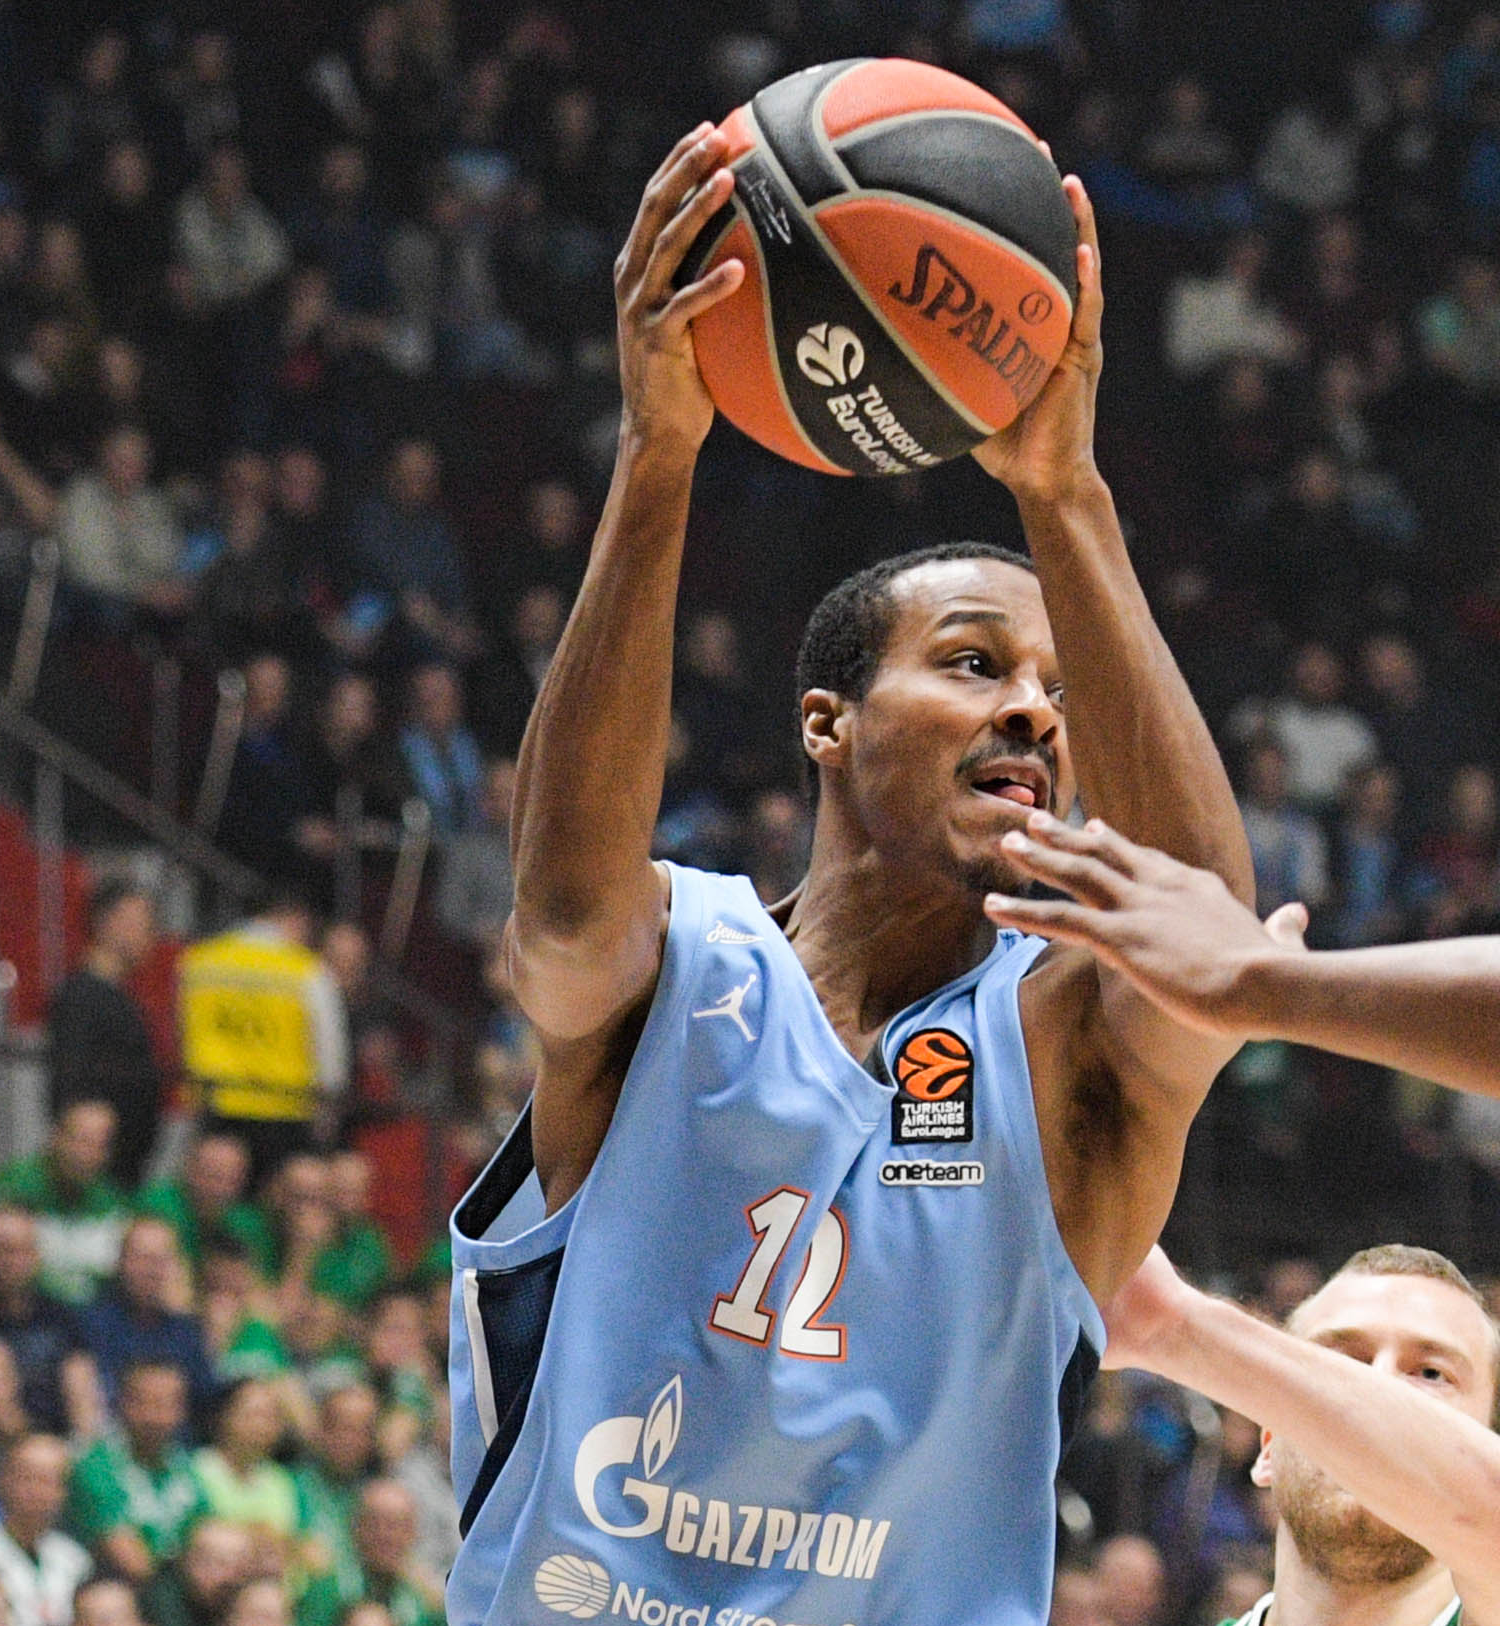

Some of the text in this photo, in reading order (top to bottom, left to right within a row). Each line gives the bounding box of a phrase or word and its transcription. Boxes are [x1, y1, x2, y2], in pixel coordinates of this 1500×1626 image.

[856, 383, 924, 459] TURKISH
[900, 1100, 965, 1117] TURKISH
[900, 1112, 965, 1127] AIRLINES
[900, 1125, 967, 1139] EuroLeague
[882, 1162, 982, 1182] oneteam
[708, 1184, 850, 1363] 12
[665, 1490, 891, 1580] GAZPROM
